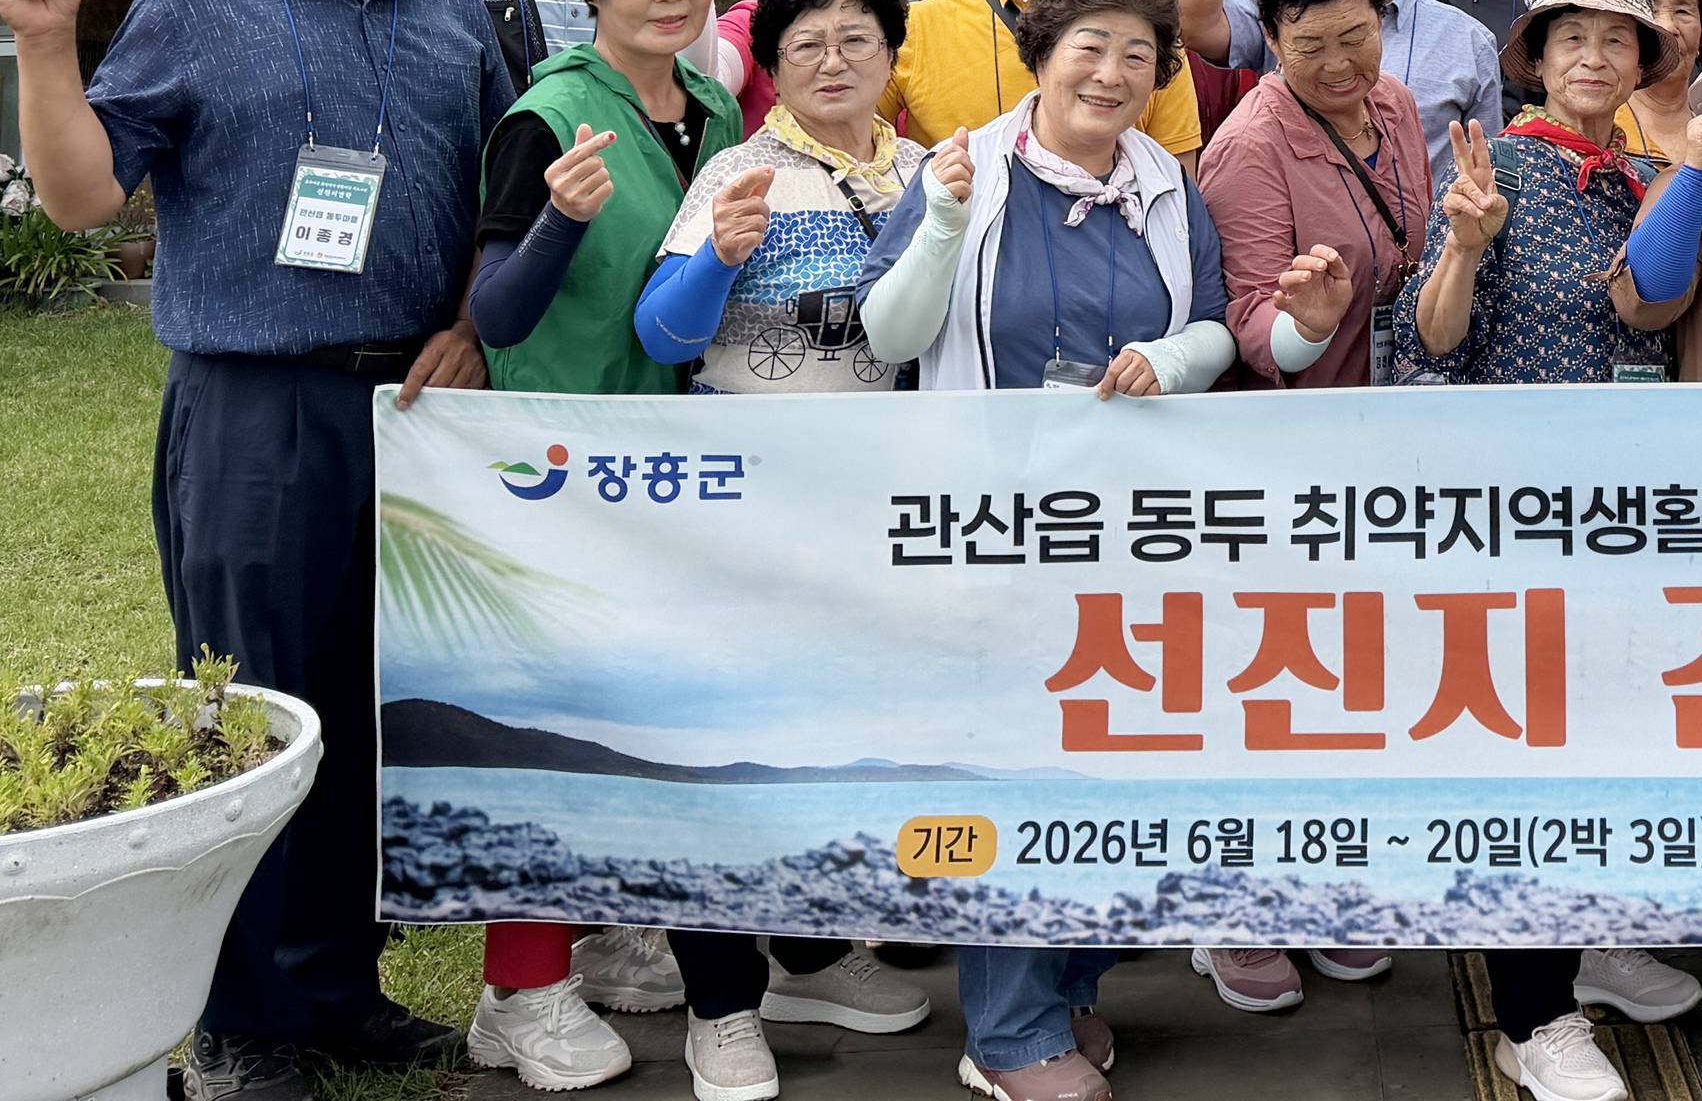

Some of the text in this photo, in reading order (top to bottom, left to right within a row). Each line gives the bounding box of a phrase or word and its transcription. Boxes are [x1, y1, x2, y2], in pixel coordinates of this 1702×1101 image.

[588, 452, 745, 504] 장흥군
[888, 490, 1104, 566] 관산읍
[1127, 489, 1268, 562] 동두
[1045, 590, 1567, 752] 선진지
[912, 825, 978, 864] 기간
[1016, 818, 1168, 867] 2026년
[1187, 818, 1254, 868] 6월
[1276, 817, 1369, 867] 18일
[1387, 835, 1410, 846] ~
[1427, 816, 1613, 868] 20일(2박
